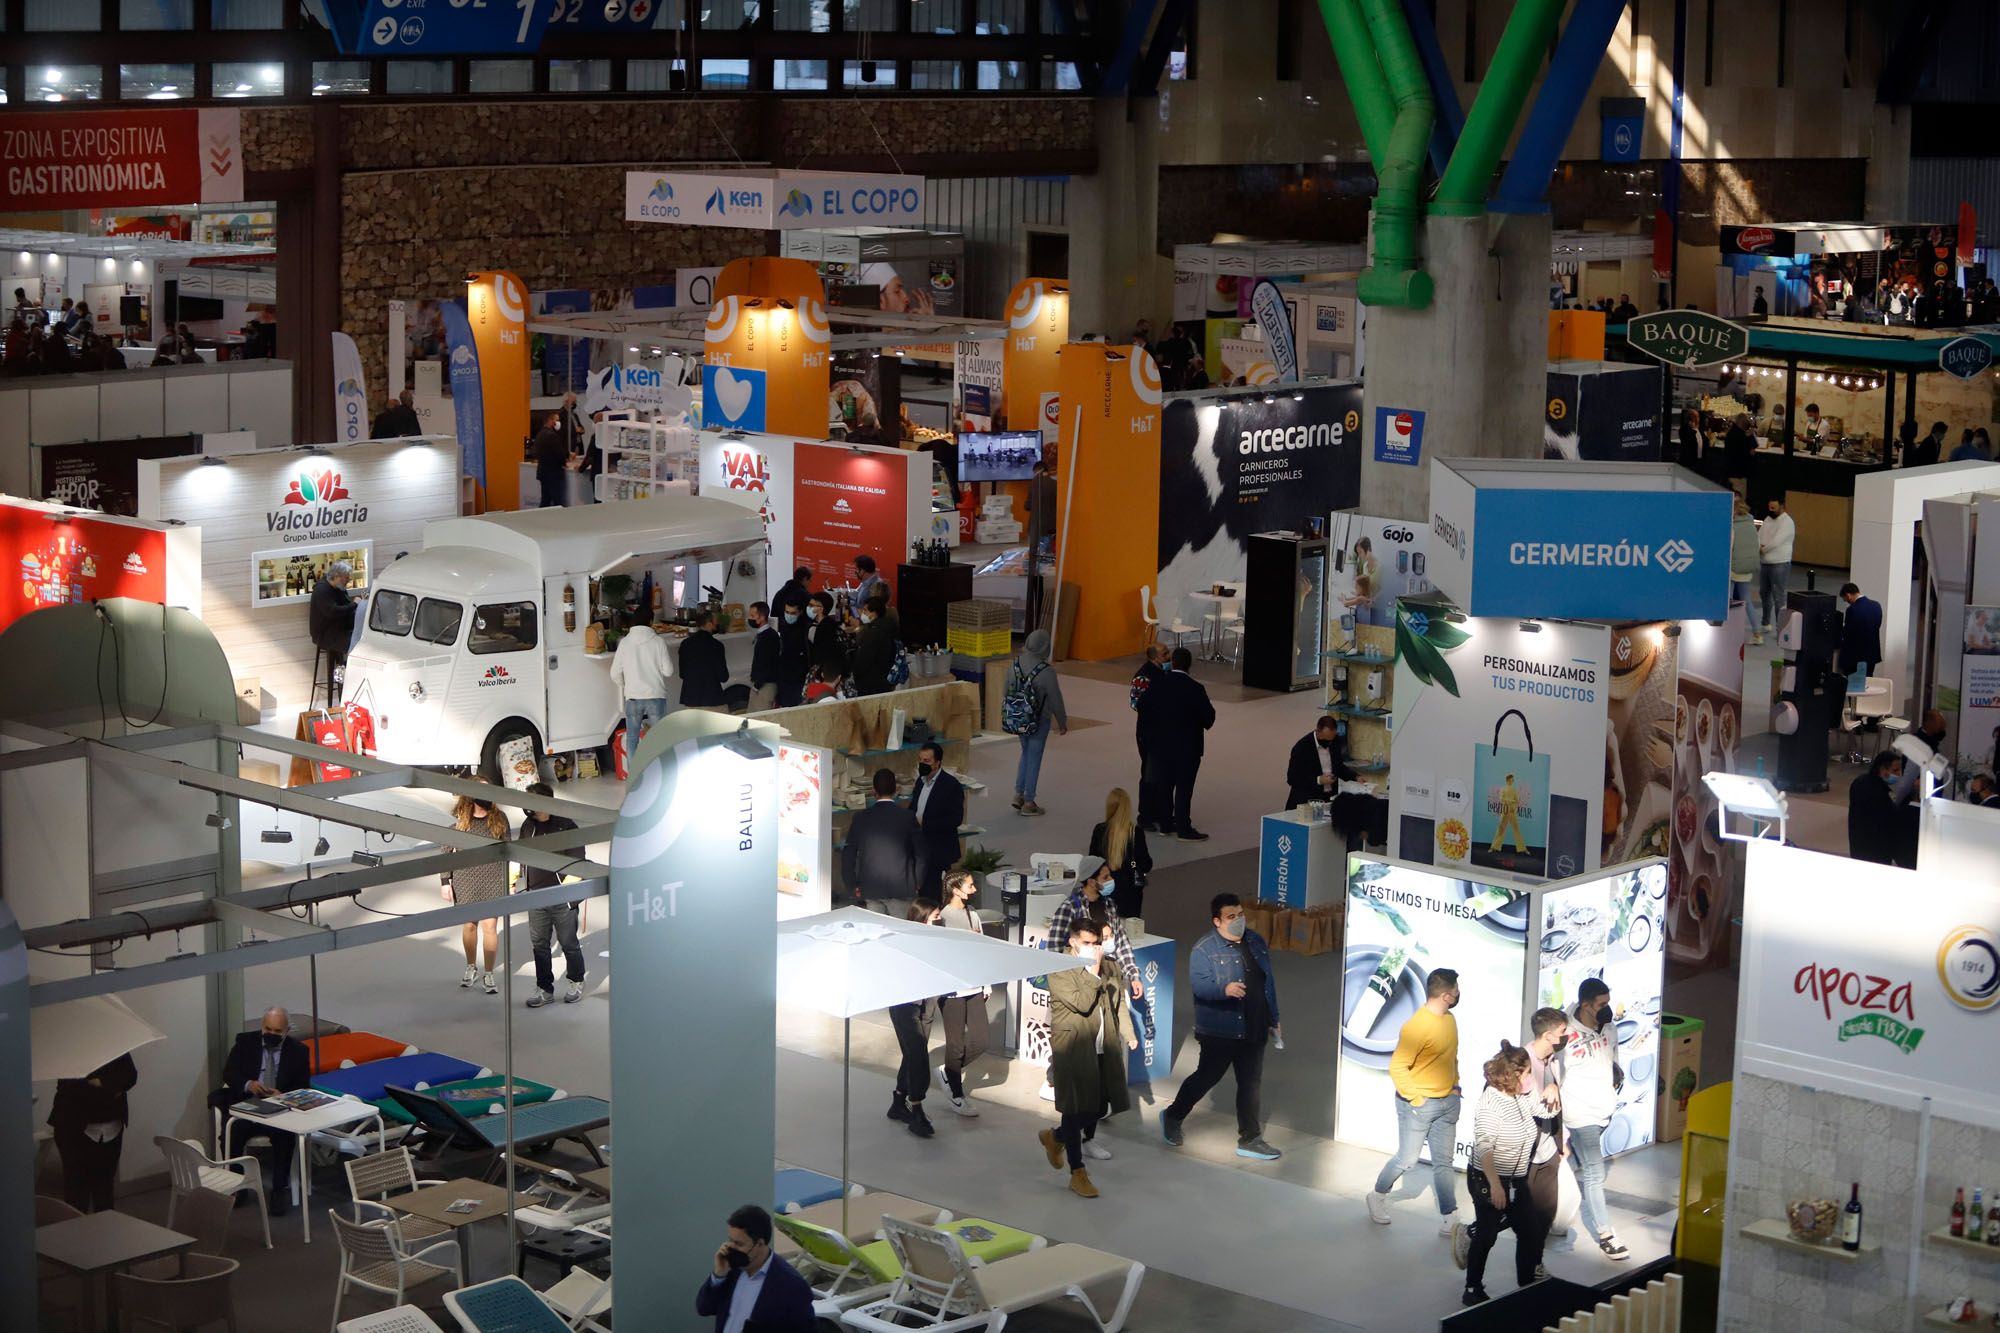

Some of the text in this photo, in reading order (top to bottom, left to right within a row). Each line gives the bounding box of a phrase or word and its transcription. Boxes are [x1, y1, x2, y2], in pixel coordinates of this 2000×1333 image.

[4, 127, 167, 159] ZONA EXPOSITIVA
[8, 156, 167, 196] GASTRONÓMICA
[641, 205, 681, 217] EL COPO
[824, 188, 919, 215] EL COPO
[958, 341, 979, 356] DOTS
[1643, 323, 1732, 351] BAQUÉ
[968, 359, 1001, 375] ALWAYS
[1239, 422, 1344, 455] arcecarne
[724, 450, 769, 481] VAL
[1239, 458, 1289, 473] CARNICEROS
[1239, 469, 1303, 485] PROFESIONALES
[283, 534, 307, 543] Grupo
[1510, 538, 1648, 568] CERMERÓN
[1484, 655, 1596, 684] PERSONALIZAMOS
[1492, 675, 1595, 703] TUS PRODUCTOS
[739, 784, 752, 851] BALLIU
[627, 881, 684, 926] H&T
[1362, 883, 1478, 921] VESTIMOS TU MESA
[1961, 960, 1985, 974] 1914
[1794, 962, 1914, 1021] apoza
[1143, 985, 1156, 1067] CERMERÓN
